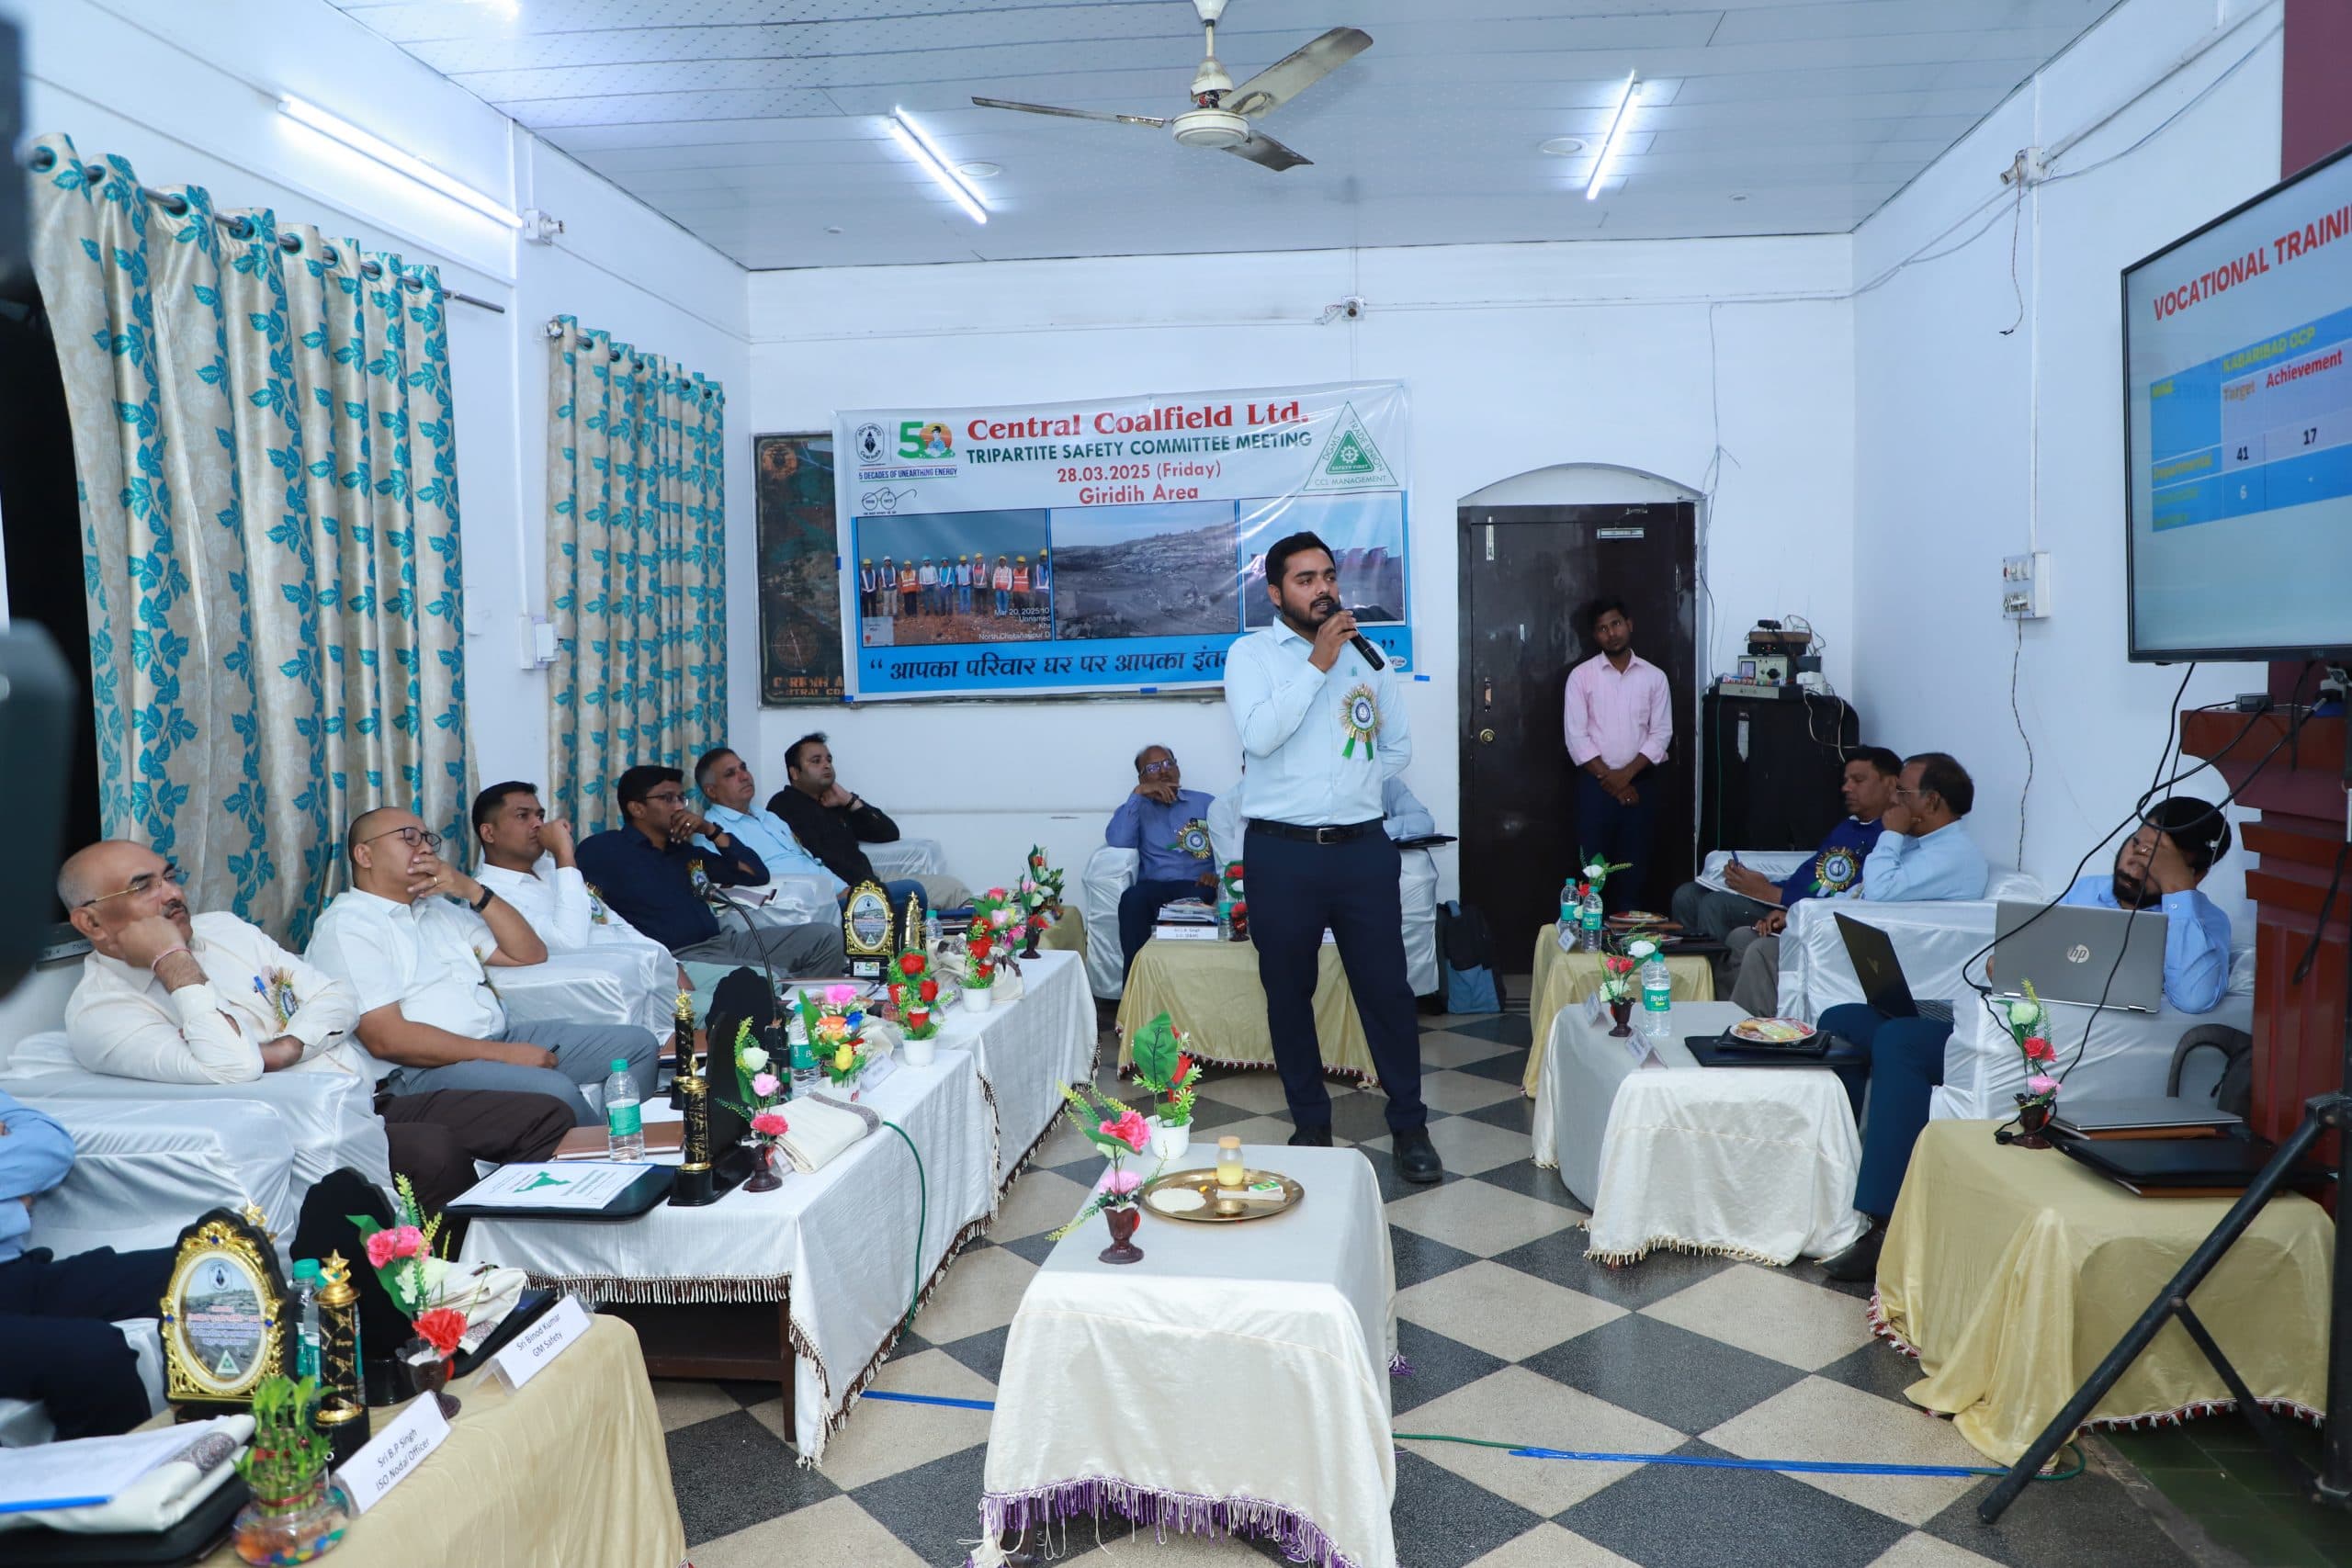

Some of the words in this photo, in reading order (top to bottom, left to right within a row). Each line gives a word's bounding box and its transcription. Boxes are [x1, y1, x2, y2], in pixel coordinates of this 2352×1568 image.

[2154, 247, 2270, 321] VOCATIONAL
[2274, 203, 2352, 265] TRAINI
[2266, 349, 2344, 389] Achievement
[967, 414, 1080, 441] Central
[1094, 405, 1233, 435] Coalfield
[1247, 401, 1309, 425] Ltd.
[967, 446, 1058, 464] TRIPARTITE
[1063, 442, 1124, 459] SAFETY
[1130, 436, 1230, 457] COMMITTEE
[1236, 431, 1313, 450] MEETING
[1322, 434, 1341, 461] DGMS
[1349, 418, 1368, 445] TRADE
[1364, 446, 1385, 471] UNION
[2236, 446, 2249, 461] 41
[2303, 427, 2318, 446] 17
[864, 470, 889, 480] DECADES
[889, 469, 898, 479] OF
[898, 468, 934, 479] UNEARTHING
[934, 468, 957, 477] ENERGY
[1057, 464, 1150, 483] 28.03.2025
[1157, 460, 1222, 481] (Friday)
[1331, 475, 1386, 485] MANAGEMENT
[1079, 482, 1145, 505] Giridih
[1152, 483, 1199, 502] Area
[2239, 484, 2247, 500] 6
[1022, 607, 1040, 615] 2025
[890, 659, 957, 680] आपका
[966, 651, 1036, 677] परिवार
[1043, 655, 1072, 675] घर
[1080, 655, 1108, 674] पर
[1114, 651, 1187, 672] आपका
[2068, 945, 2088, 963] hp
[515, 1339, 527, 1351] Sri
[525, 1326, 544, 1344] Binod
[542, 1314, 560, 1331] Kumar
[532, 1344, 546, 1357] GM
[543, 1332, 563, 1349] Safety
[377, 1451, 390, 1468] Sri
[399, 1428, 418, 1449] Singh
[375, 1473, 390, 1492] ISO
[389, 1455, 410, 1480] Nodal
[408, 1438, 430, 1461] Officer
